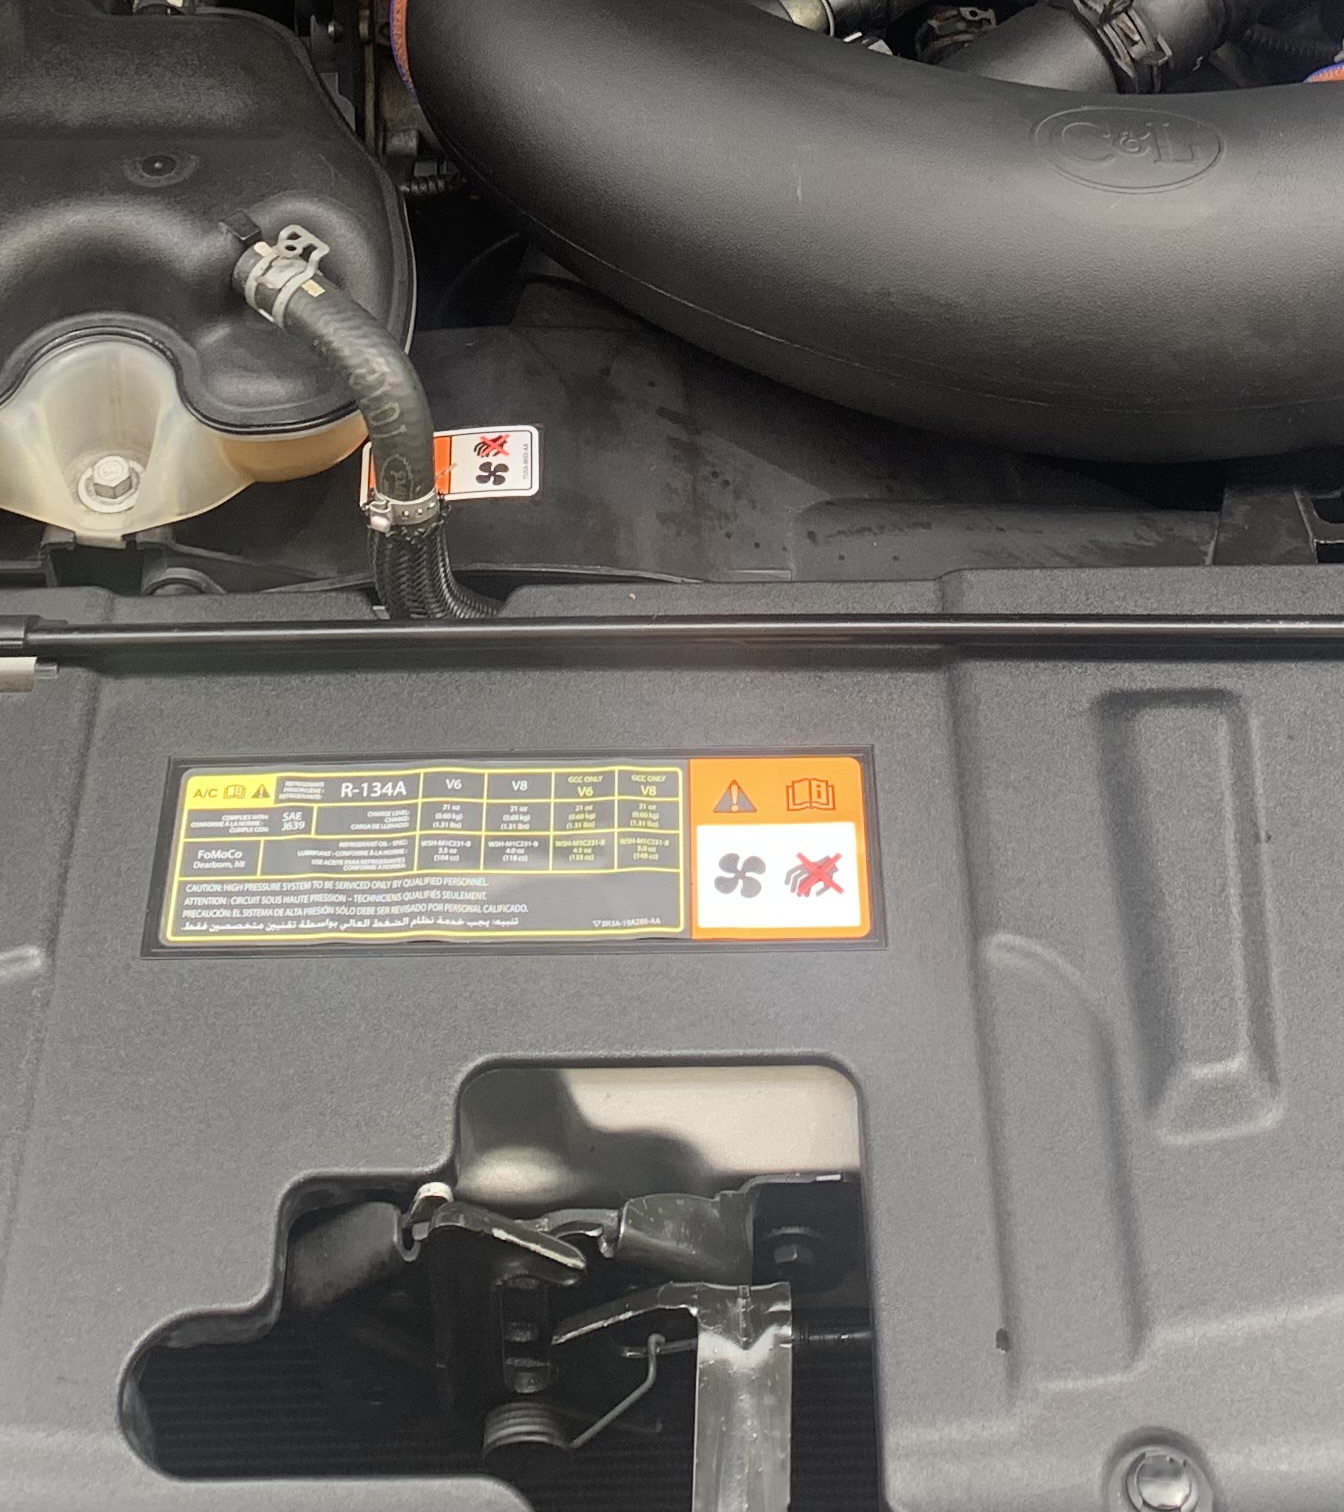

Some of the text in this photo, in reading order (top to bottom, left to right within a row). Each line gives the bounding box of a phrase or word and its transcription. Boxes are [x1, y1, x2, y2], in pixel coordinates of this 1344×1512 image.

[446, 778, 462, 790] V6
[567, 775, 603, 784] GCC ONLY
[631, 774, 666, 783] GCC ONLY
[341, 781, 407, 798] R-134A
[512, 780, 528, 791] V8
[641, 785, 657, 796] V8
[193, 788, 219, 798] A/C
[577, 786, 594, 797] V6
[282, 812, 303, 821] SAE
[281, 821, 305, 832] J639
[197, 849, 243, 860] FoMoCo
[193, 860, 245, 870] Dearborn, MI
[186, 884, 222, 893] CAUTION:
[223, 883, 243, 892] HIGH
[244, 883, 281, 891] PRESSURE
[281, 882, 311, 890] SYSTEM
[312, 881, 323, 889] TO
[335, 880, 371, 889] SERVICED
[371, 880, 391, 889] ONLY
[392, 880, 402, 888] BY
[403, 878, 442, 887] QUALIFIED
[443, 877, 489, 886] PERSONNEL.
[184, 890, 487, 905] ATTENTION CIRCUIT SOUS HAUTE PRESSION TECHNICIENS QUALIFIÉS SEULEMENT.
[182, 903, 529, 918] PRECAUCIÓN: EL SISTEMA DE ALTA PRESIÓN SÓLO DEBE SER REVISADO POR PERSONAL CALIFICADO.
